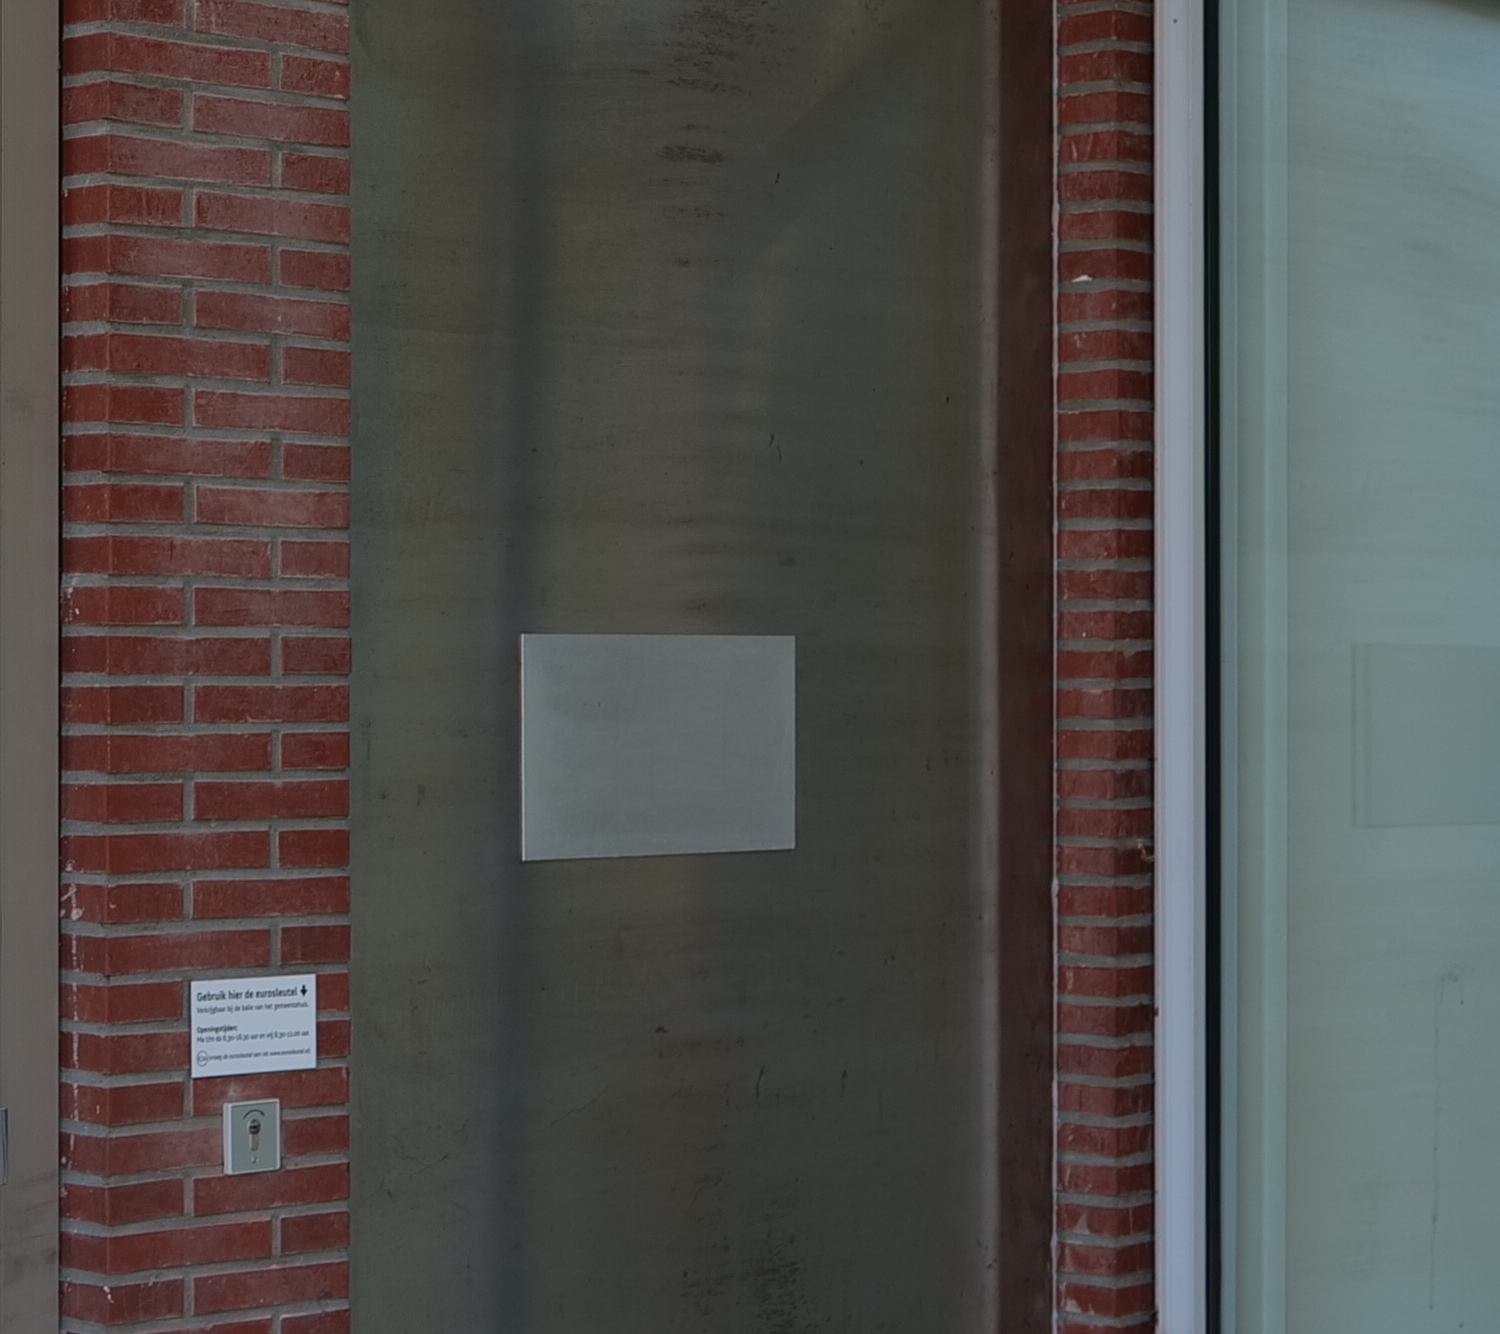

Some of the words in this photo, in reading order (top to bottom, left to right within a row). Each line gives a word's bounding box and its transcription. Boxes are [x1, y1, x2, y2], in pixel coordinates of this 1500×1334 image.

[196, 990, 226, 1002] Gebruik
[228, 989, 243, 1000] hier
[244, 988, 254, 999] de
[255, 986, 298, 998] eurosleutel
